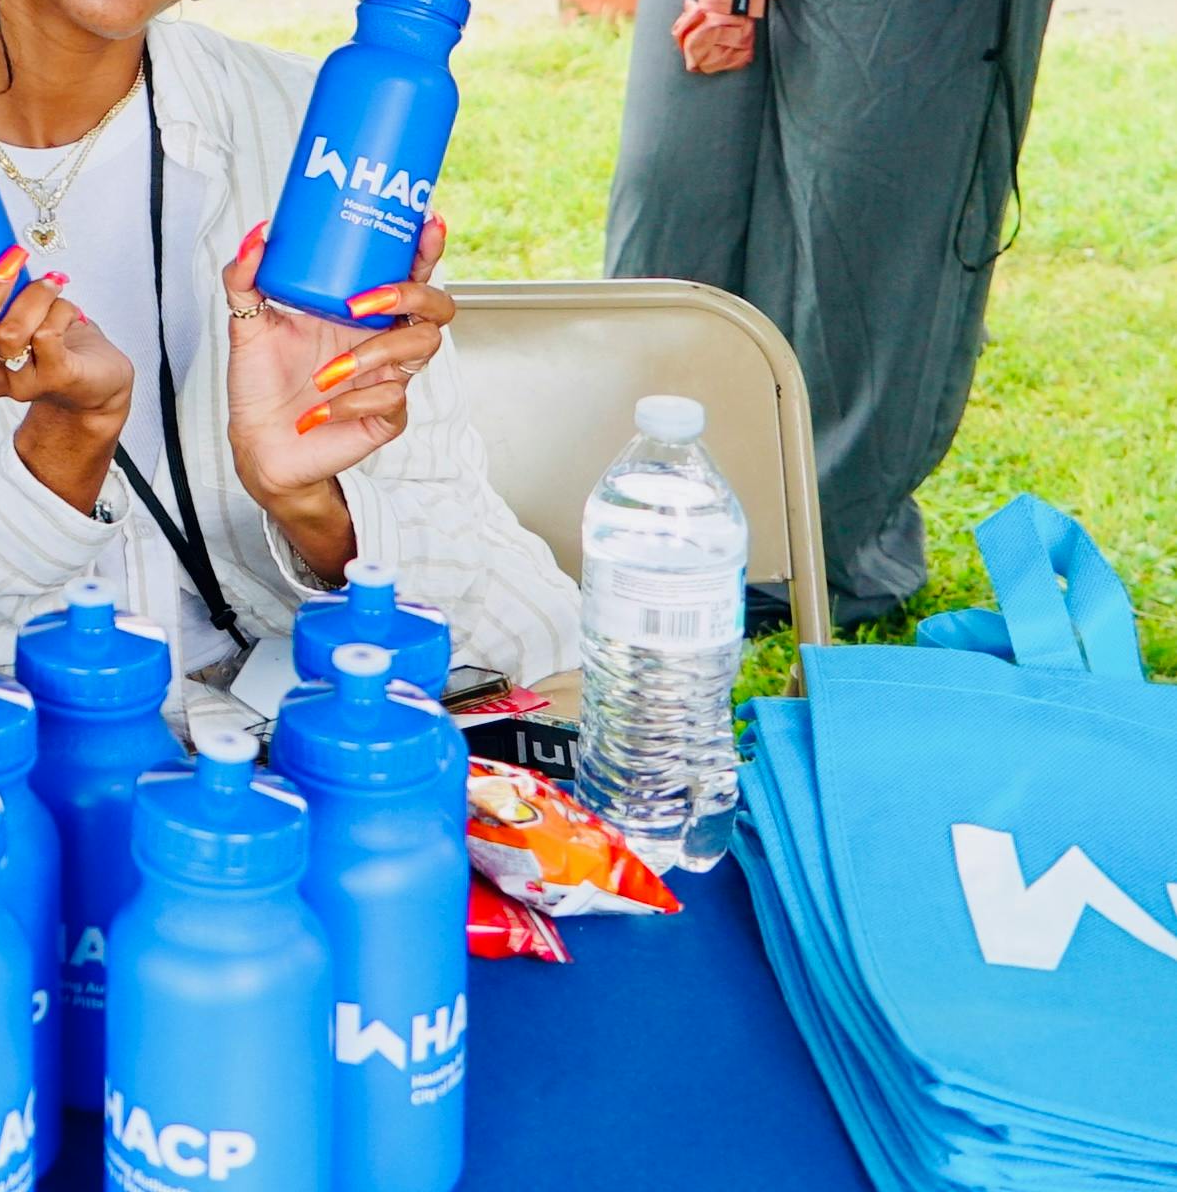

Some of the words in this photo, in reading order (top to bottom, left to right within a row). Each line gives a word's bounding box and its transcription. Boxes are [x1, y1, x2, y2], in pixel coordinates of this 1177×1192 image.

[349, 156, 434, 213] HAC
[340, 209, 362, 225] City
[362, 217, 374, 227] of
[343, 197, 385, 220] Housing
[411, 992, 467, 1063] HA
